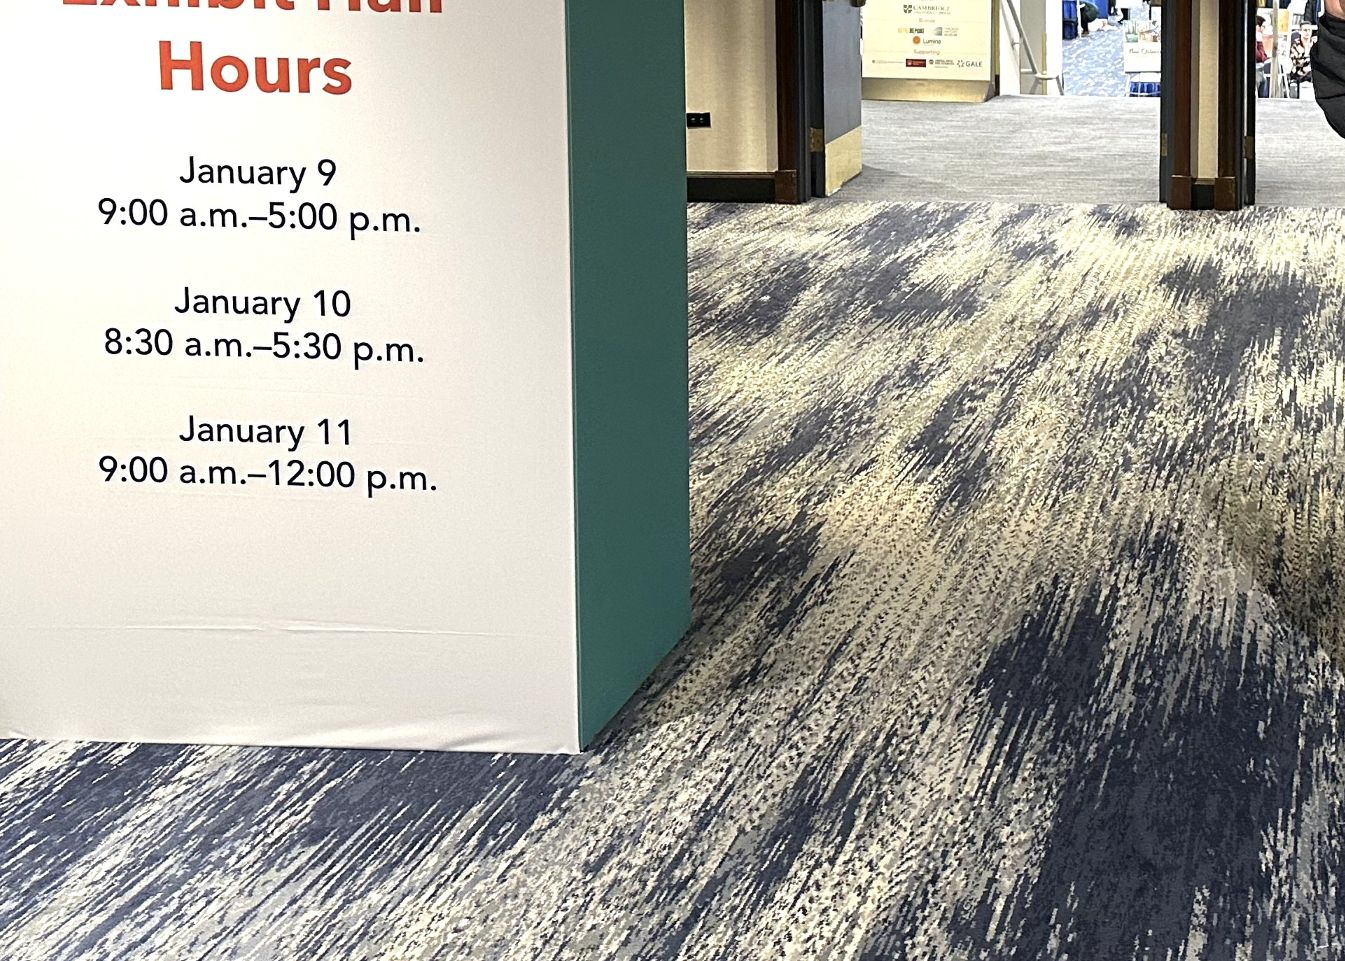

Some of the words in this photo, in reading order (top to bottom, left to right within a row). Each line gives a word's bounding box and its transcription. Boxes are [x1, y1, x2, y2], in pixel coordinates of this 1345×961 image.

[159, 41, 352, 95] Hours
[180, 156, 306, 193] January
[318, 159, 336, 186] 9
[99, 198, 167, 225] 9:00
[350, 212, 420, 240] p.m.
[175, 287, 300, 323] January
[314, 290, 350, 317] 10
[105, 328, 173, 355] 8:30
[354, 342, 423, 370] p.m.
[179, 415, 304, 452] January
[318, 419, 349, 445] 11
[99, 456, 167, 483] 9:00
[368, 471, 436, 498] p.m.
